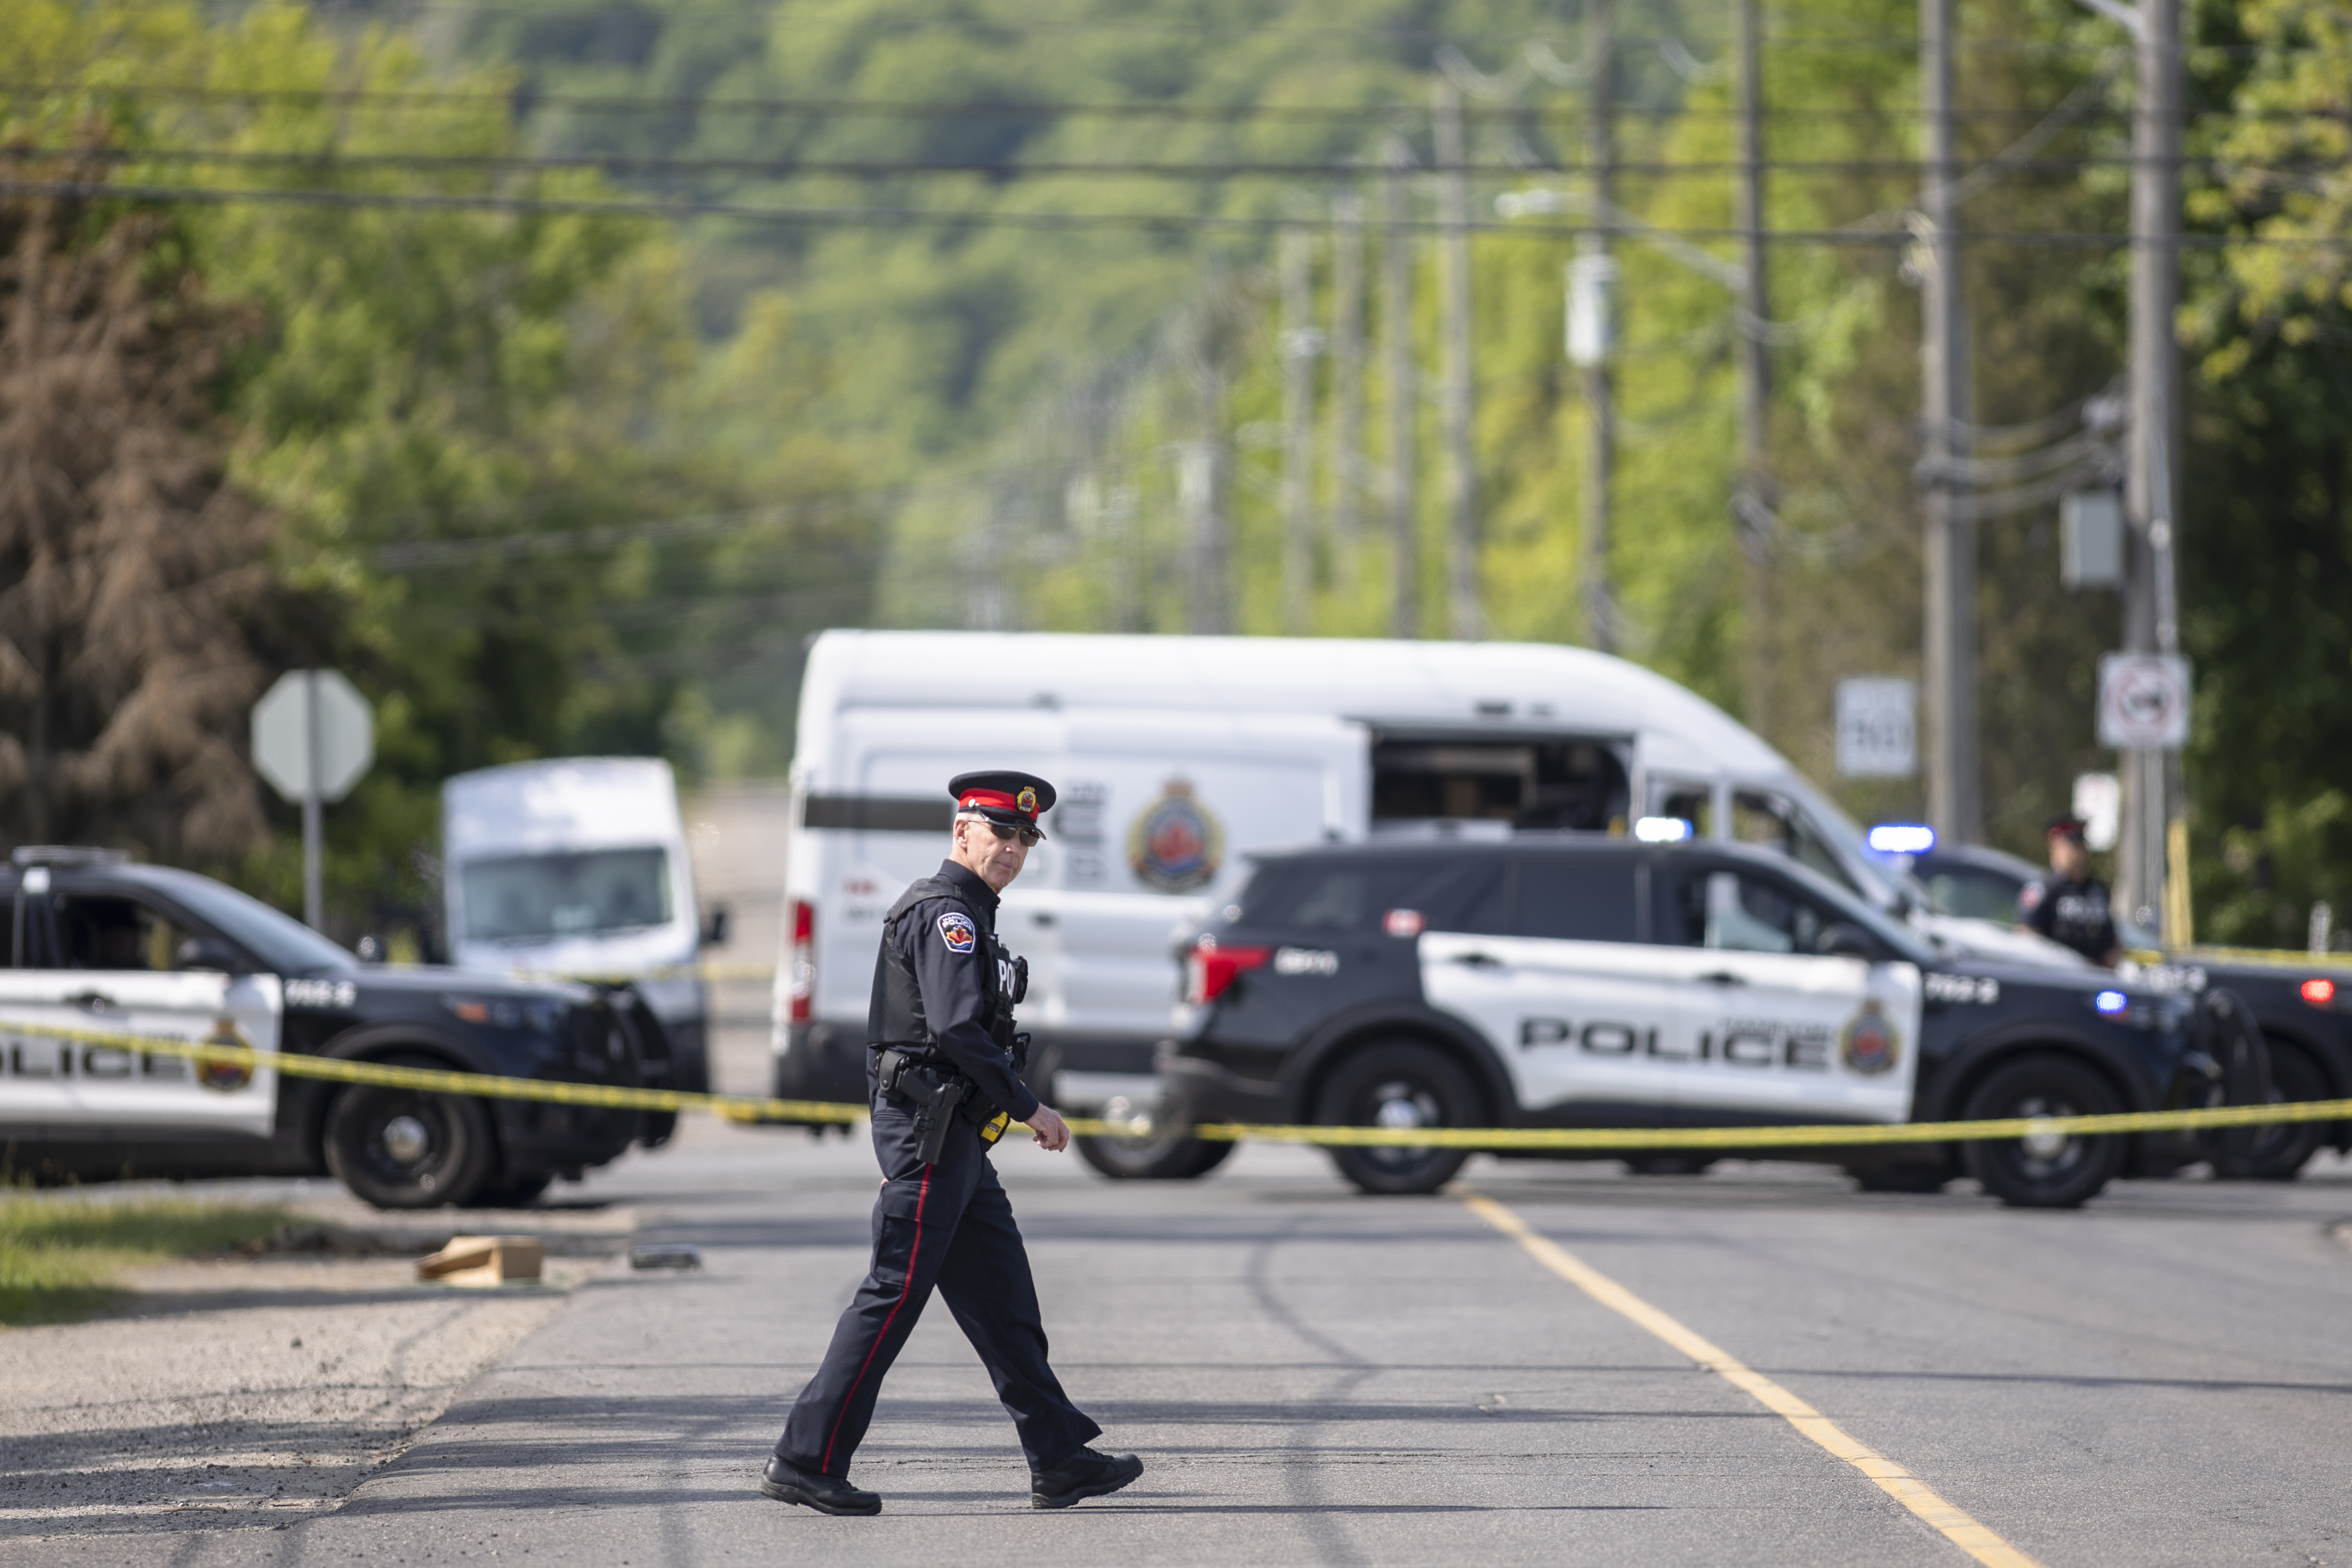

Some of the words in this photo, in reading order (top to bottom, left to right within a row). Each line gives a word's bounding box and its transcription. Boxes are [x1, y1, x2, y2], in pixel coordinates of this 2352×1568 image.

[942, 919, 972, 932] POLICE
[0, 1039, 188, 1080] LICE
[1520, 1016, 1831, 1072] POLICE
